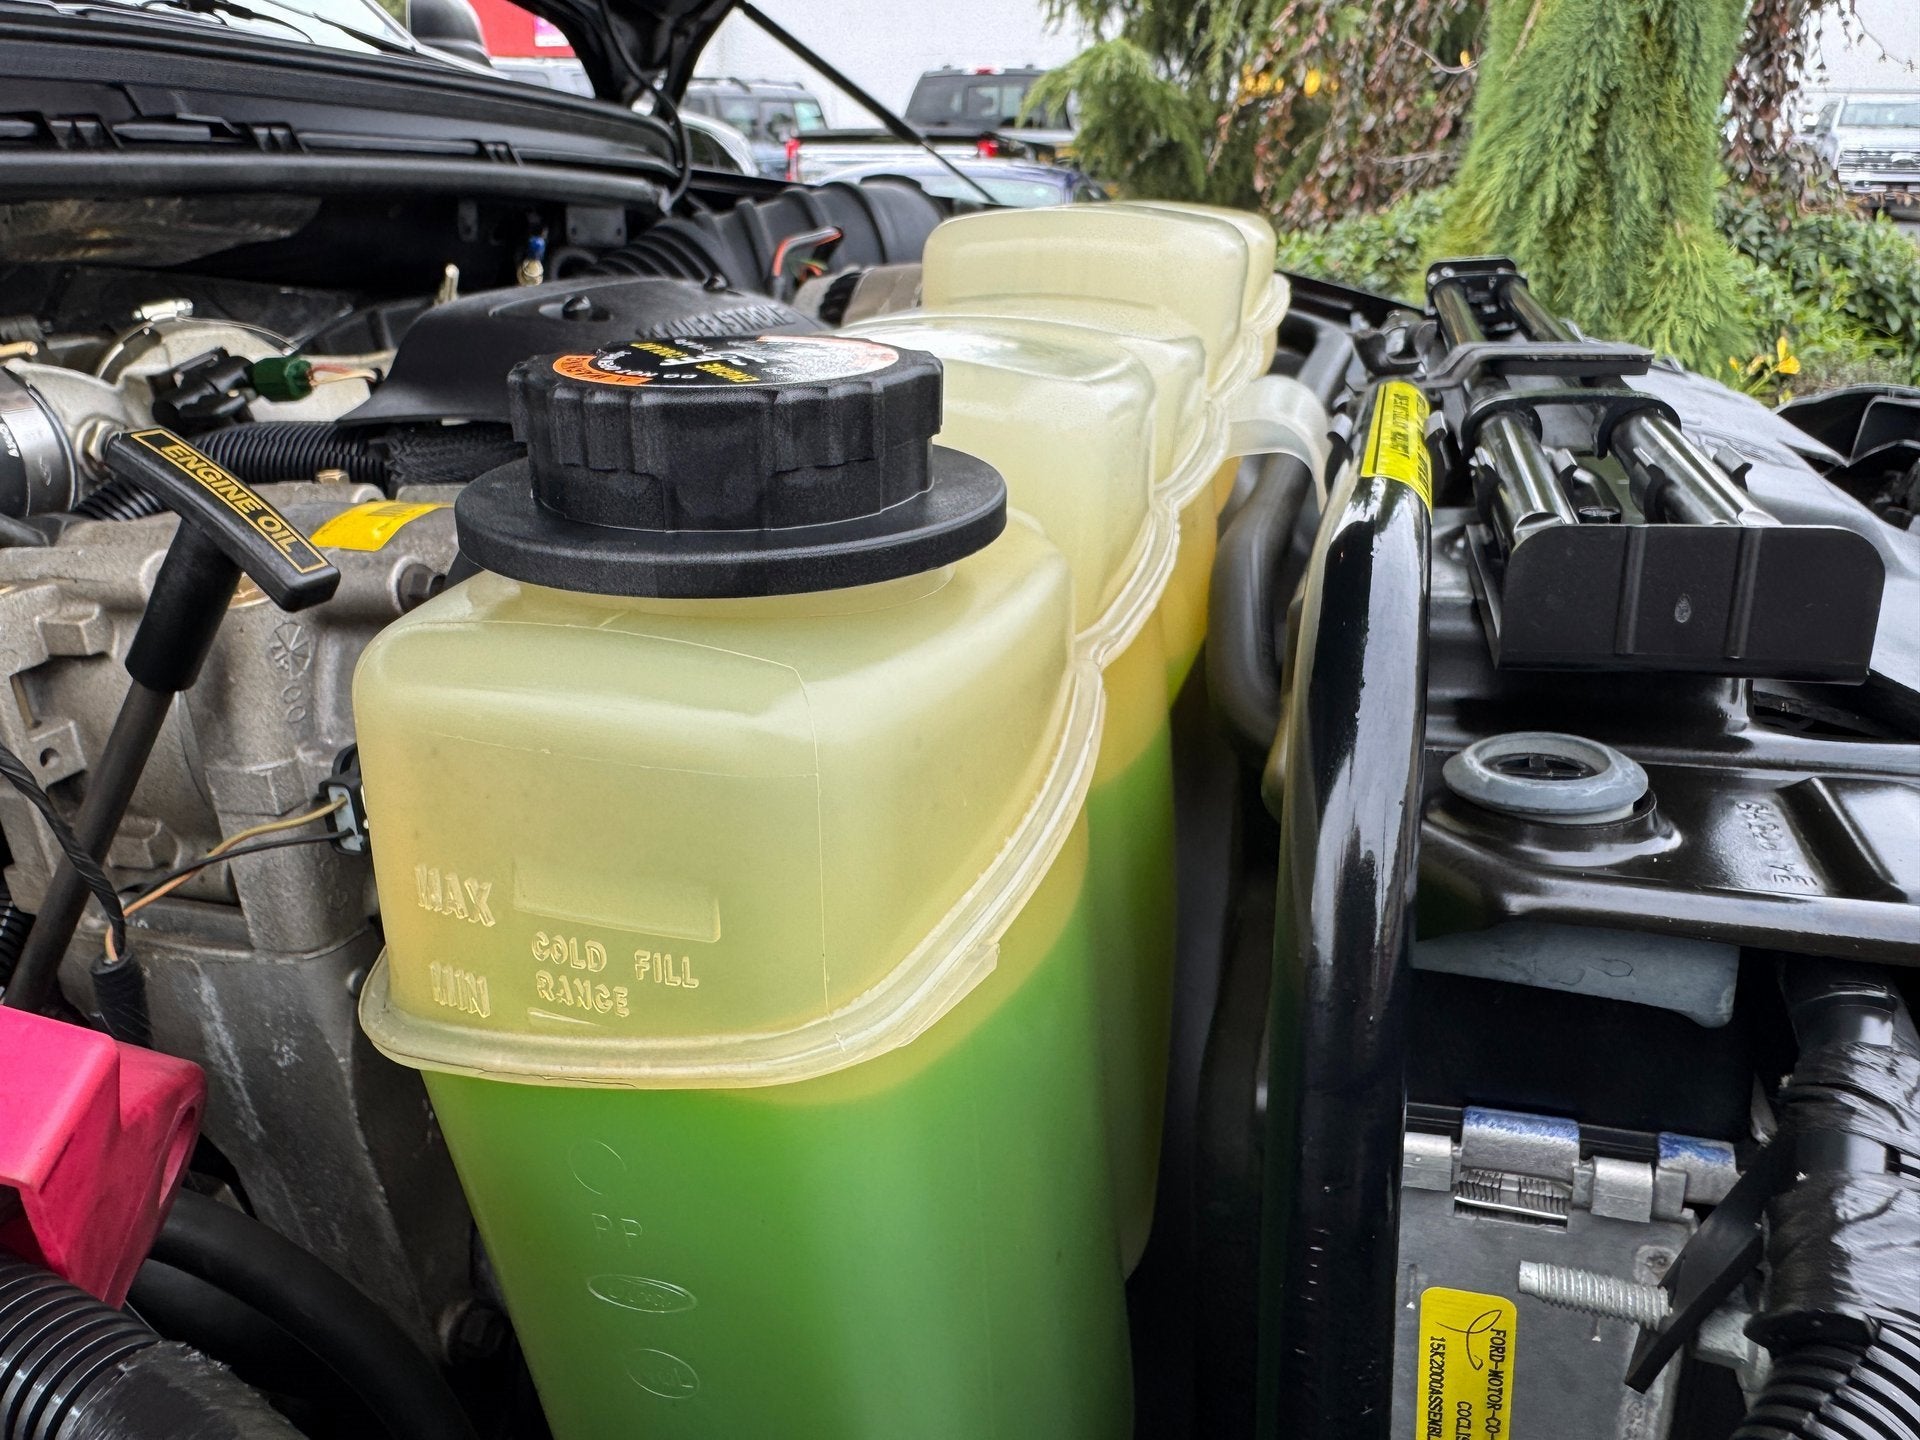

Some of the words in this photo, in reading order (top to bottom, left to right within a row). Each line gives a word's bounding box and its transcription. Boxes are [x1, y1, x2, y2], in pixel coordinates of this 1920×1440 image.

[161, 443, 263, 514] ENGINE
[257, 515, 299, 554] OIL
[414, 863, 496, 928] MAX
[531, 930, 608, 973] COLD
[634, 949, 700, 989] FILL
[429, 960, 491, 1019] MIN
[535, 969, 631, 1018] RANGE
